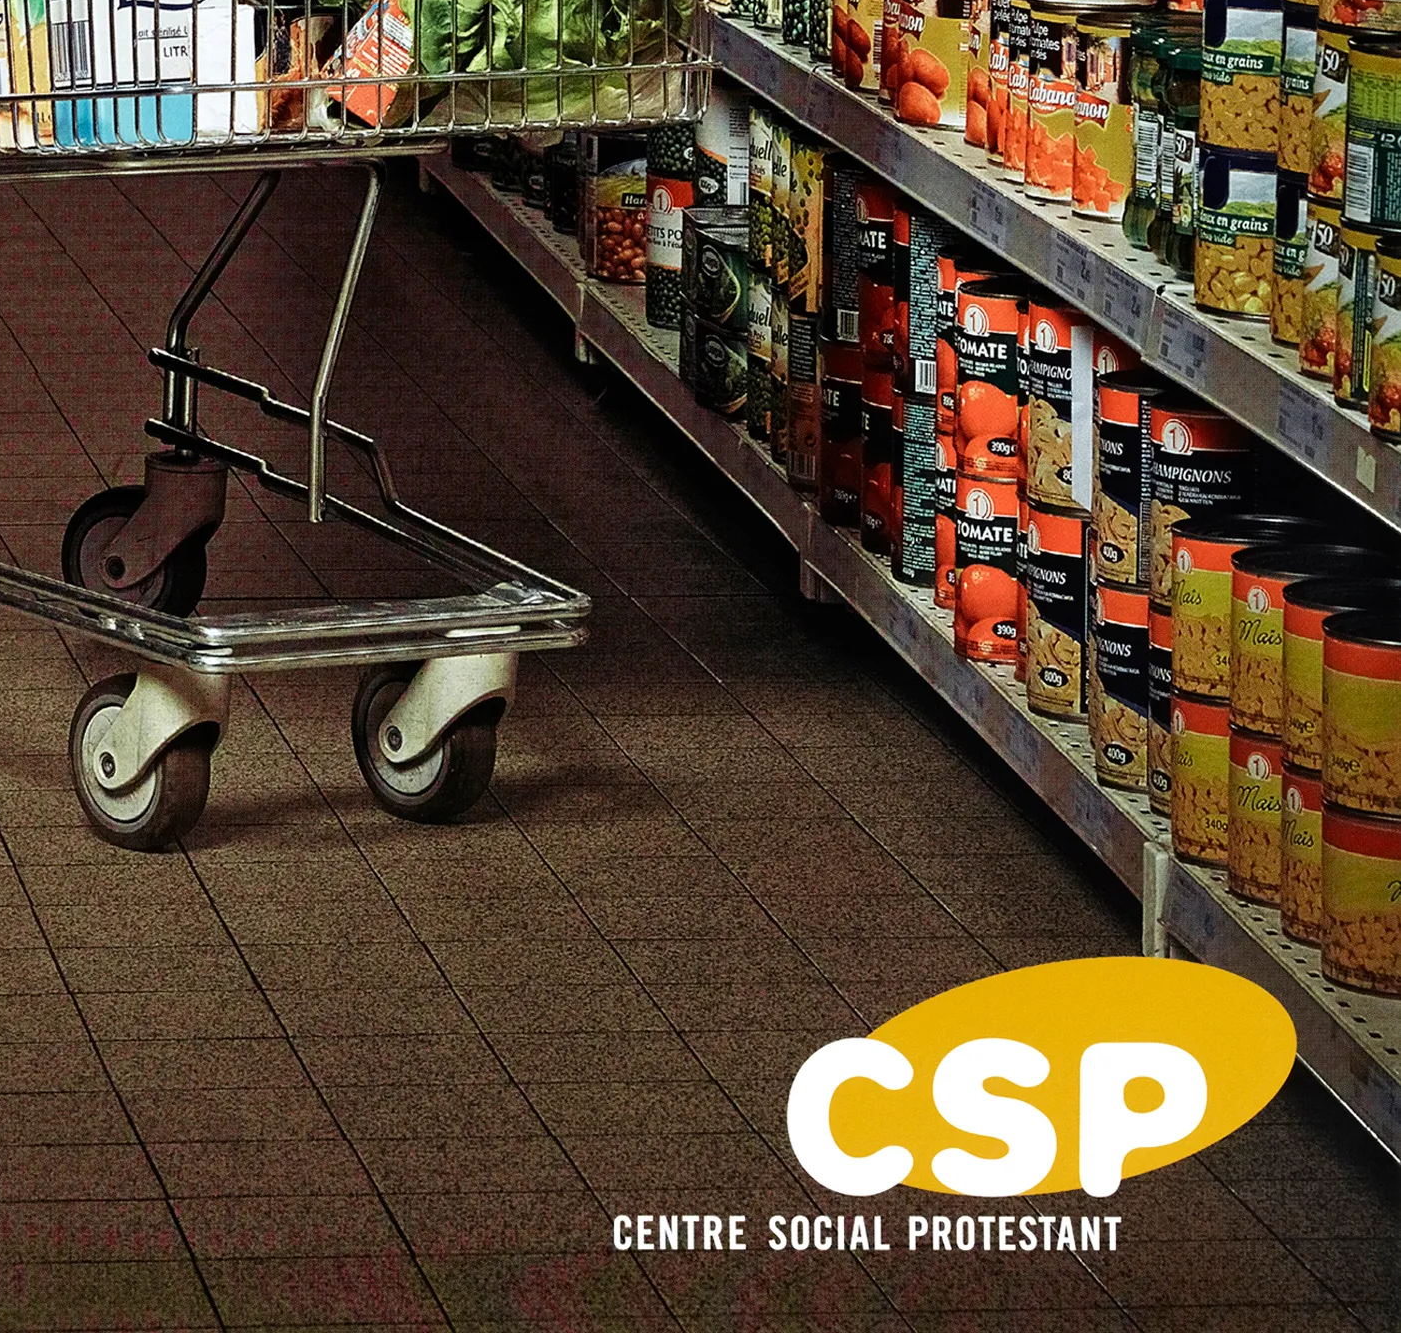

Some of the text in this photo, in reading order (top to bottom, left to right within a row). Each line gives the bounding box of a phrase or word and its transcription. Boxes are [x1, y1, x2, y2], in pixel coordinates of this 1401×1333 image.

[1227, 56, 1263, 71] grains
[1229, 216, 1268, 233] grains
[957, 520, 1013, 543] TOMATE
[1043, 671, 1062, 686] 800g
[1107, 747, 1127, 764] 400g
